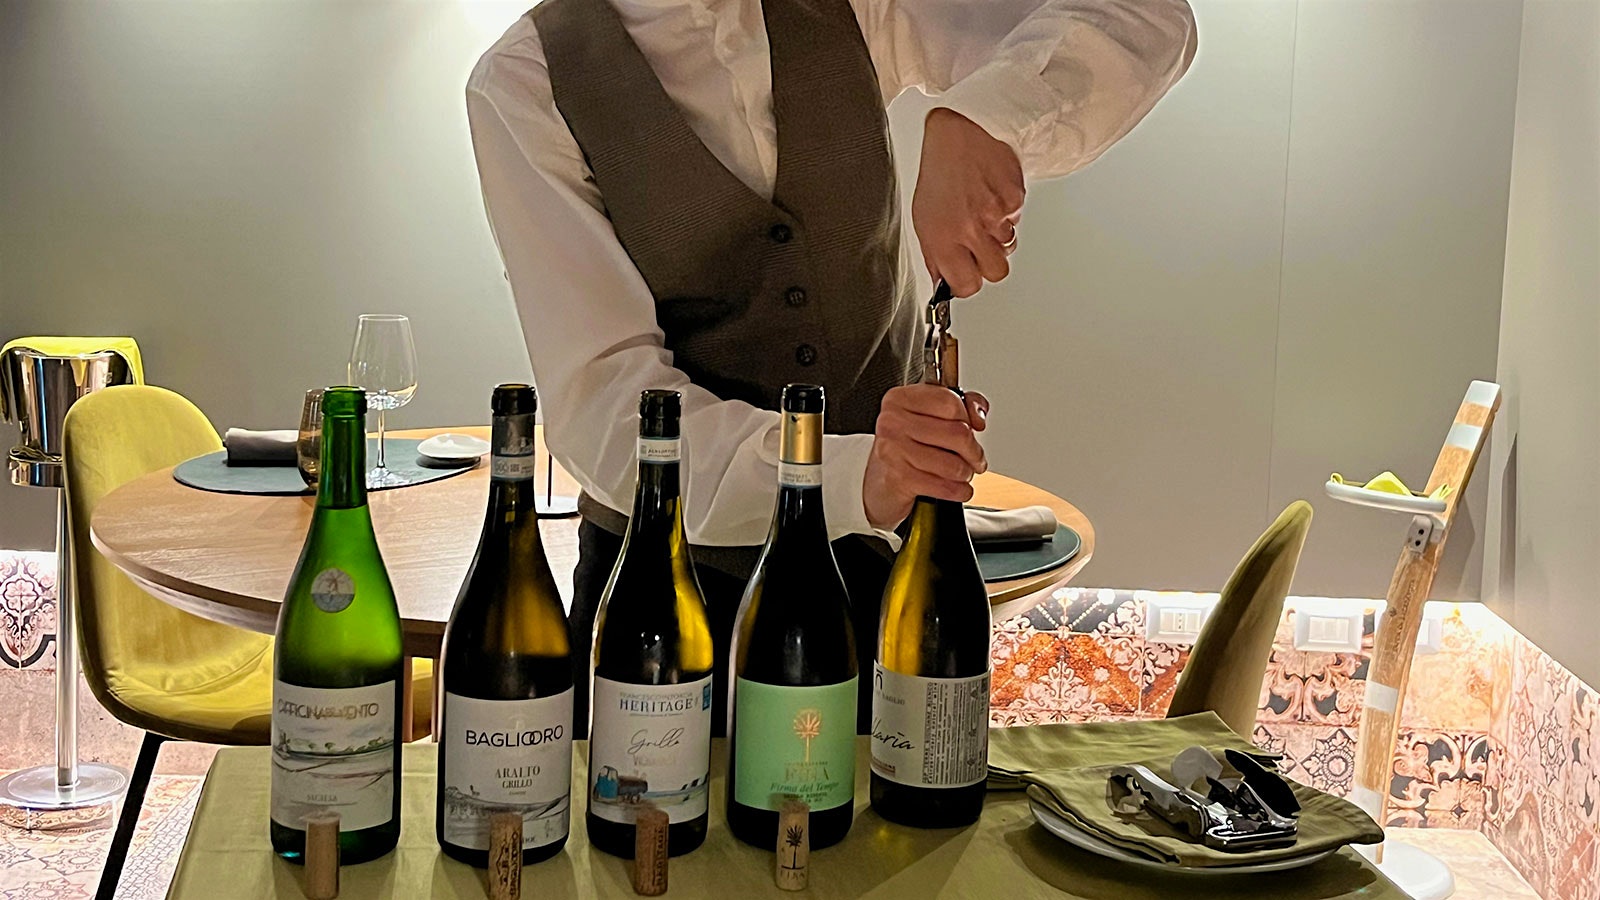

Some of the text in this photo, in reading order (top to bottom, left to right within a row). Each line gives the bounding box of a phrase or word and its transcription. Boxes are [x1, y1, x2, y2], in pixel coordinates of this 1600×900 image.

[619, 697, 694, 713] HERITAGE
[627, 727, 685, 756] Grillo
[495, 765, 541, 779] ARALTO
[502, 778, 533, 789] GRILLO
